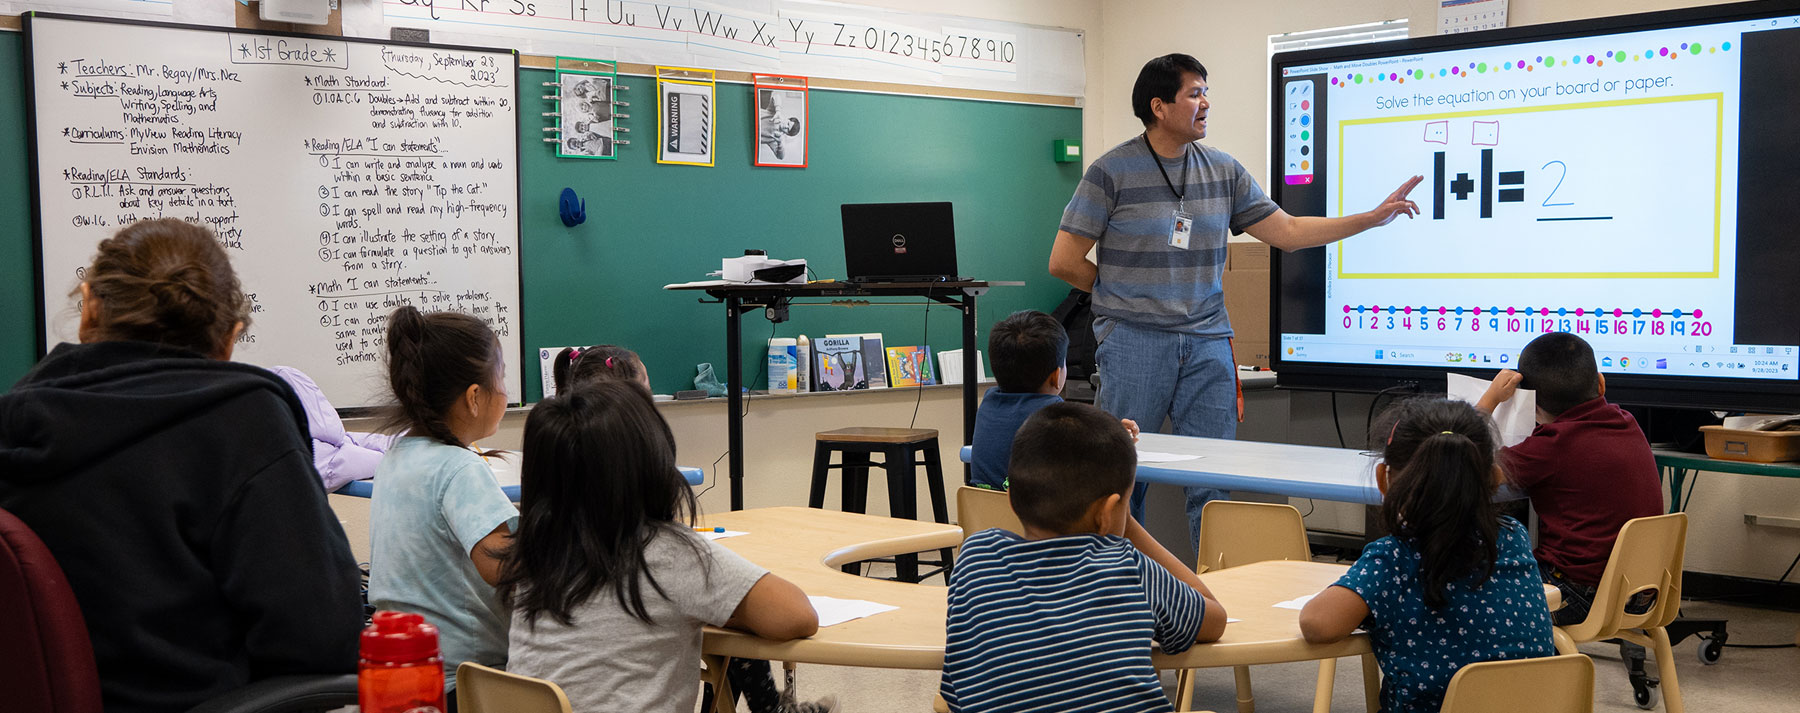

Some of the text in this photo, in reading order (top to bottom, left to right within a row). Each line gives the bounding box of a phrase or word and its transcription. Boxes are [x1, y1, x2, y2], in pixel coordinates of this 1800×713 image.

[253, 38, 322, 63] 1st Grade
[432, 53, 478, 70] September
[136, 64, 159, 77] Mr.
[470, 69, 496, 84] 2023
[315, 75, 339, 87] Math
[405, 93, 495, 106] Add and subtract within
[1376, 76, 1674, 110] Solve the equation on your board or paper.
[199, 101, 216, 111] and
[369, 106, 414, 119] demonstrating
[449, 106, 461, 117] for
[466, 108, 493, 118] addition
[670, 96, 678, 137] WARNING
[372, 119, 448, 130] and subtraction with
[172, 127, 205, 145] Reading
[209, 127, 242, 145] Literacy
[131, 142, 230, 155] Envision Mathematics
[383, 143, 396, 152] can
[346, 162, 360, 170] can
[365, 158, 384, 169] write
[388, 158, 401, 169] and
[406, 157, 436, 174] analyze
[450, 161, 467, 169] noun
[471, 158, 484, 170] and
[334, 170, 434, 183] within basic sentence
[119, 183, 230, 199] Ask and answer questions
[344, 184, 463, 200] can read the story the
[120, 198, 140, 209] about
[148, 199, 163, 211] key
[169, 195, 194, 207] details
[344, 199, 507, 221] can spell and read my high-frequency
[117, 214, 137, 225] With
[184, 212, 199, 224] and
[204, 211, 239, 229] support
[342, 228, 462, 247] can illustrate the setting of
[343, 243, 511, 260] can formulate question to get answers
[342, 261, 363, 271] from
[318, 279, 379, 294] Math can
[344, 302, 357, 310] can
[366, 301, 378, 309] use
[383, 294, 411, 308] doubles
[419, 291, 428, 304] to
[433, 291, 451, 303] solve
[472, 302, 508, 314] have the
[345, 318, 360, 326] can
[1343, 316, 1712, 336] 0 1 2 3 4 5 6 7 8 9 10 11 12 13 14 15 16 17 18 19 20
[336, 329, 357, 340] same
[336, 338, 368, 351] used to
